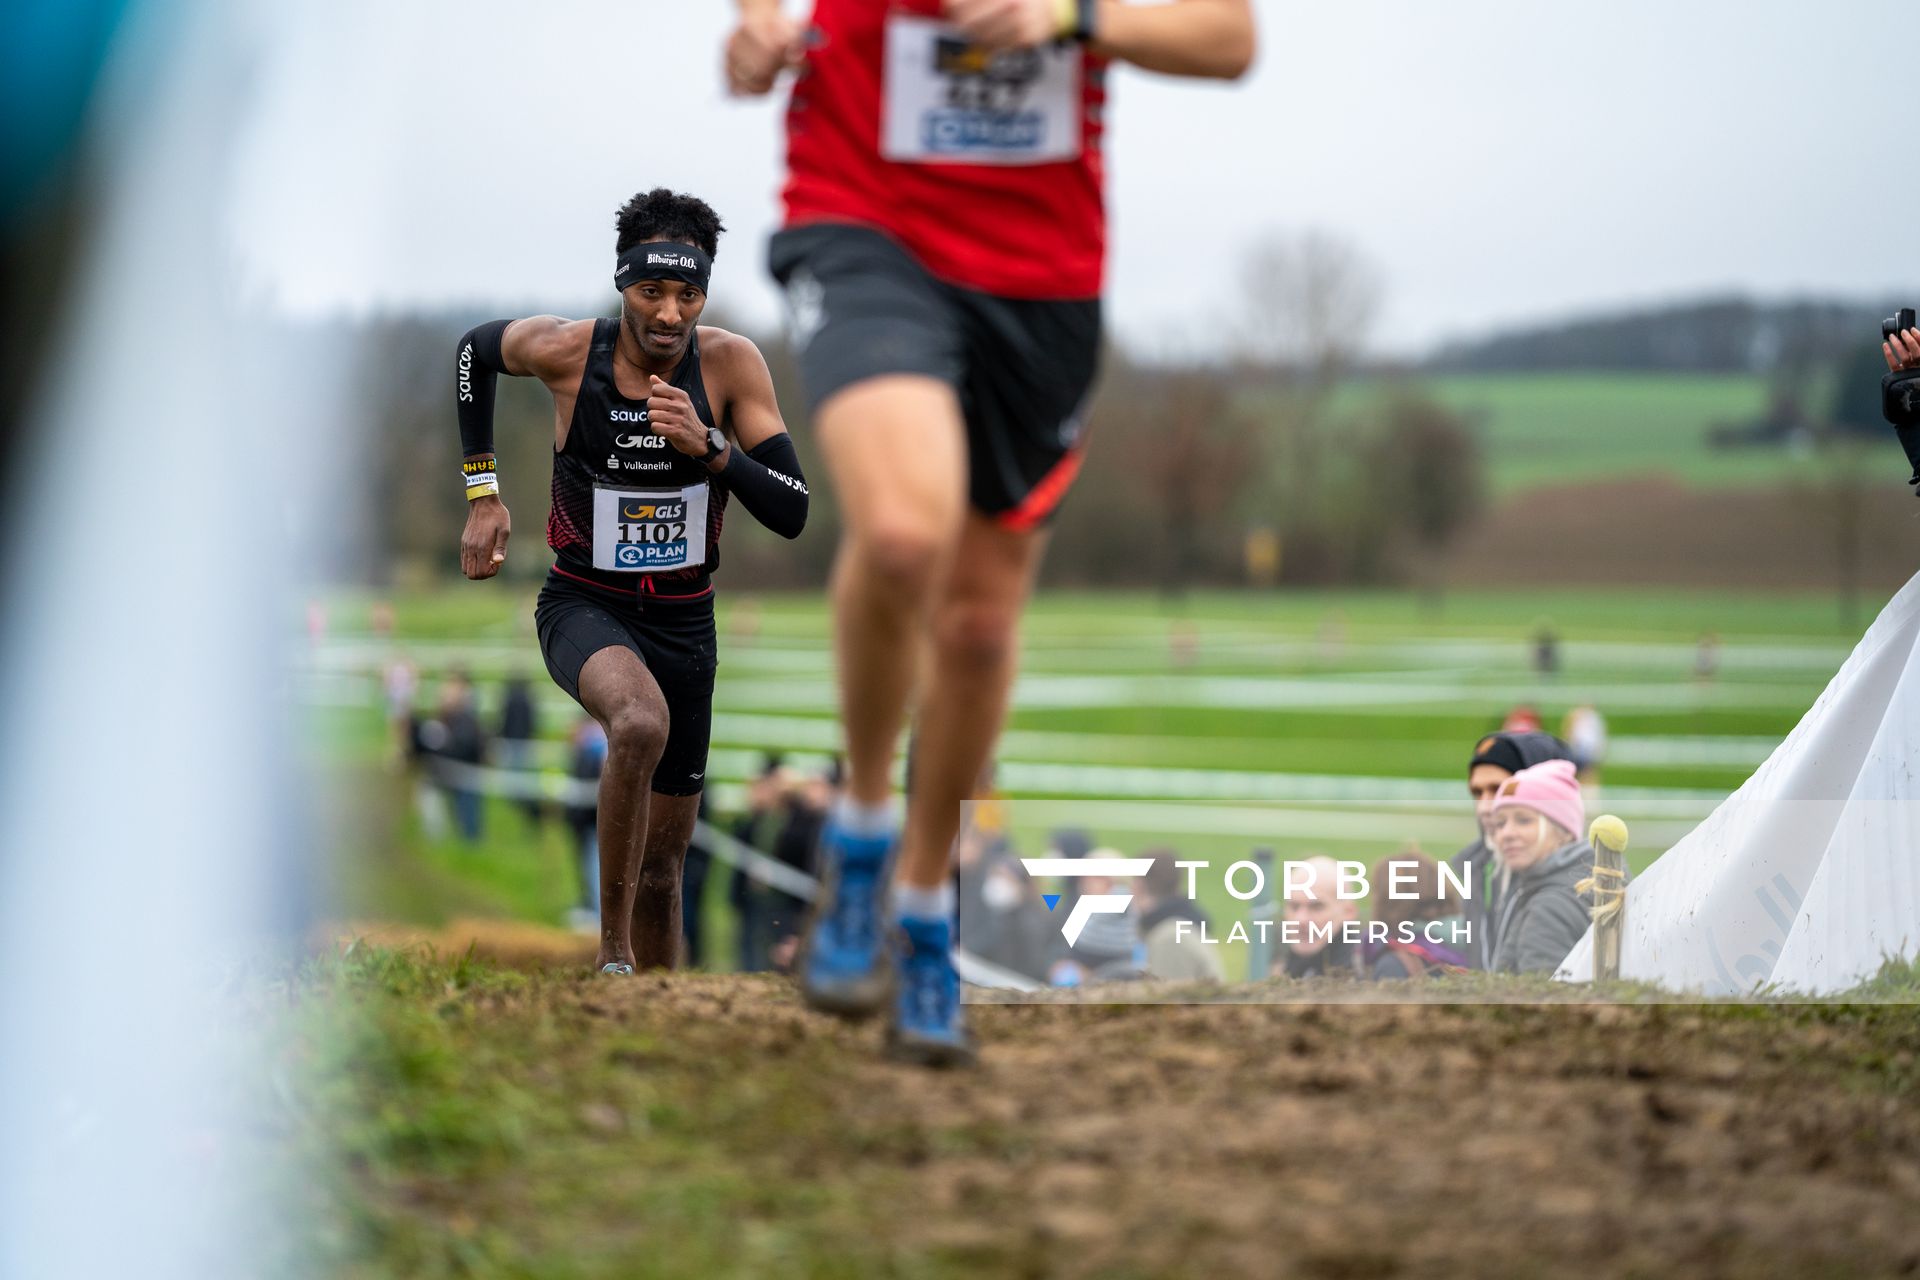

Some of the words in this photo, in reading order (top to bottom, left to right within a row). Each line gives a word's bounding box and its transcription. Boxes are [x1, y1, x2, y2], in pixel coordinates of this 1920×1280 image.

[610, 410, 648, 422] sauc
[642, 435, 666, 448] GLS
[623, 461, 672, 470] Vulkaneifel
[655, 504, 682, 519] GLS
[618, 522, 686, 544] 1102
[646, 545, 685, 558] PLAN
